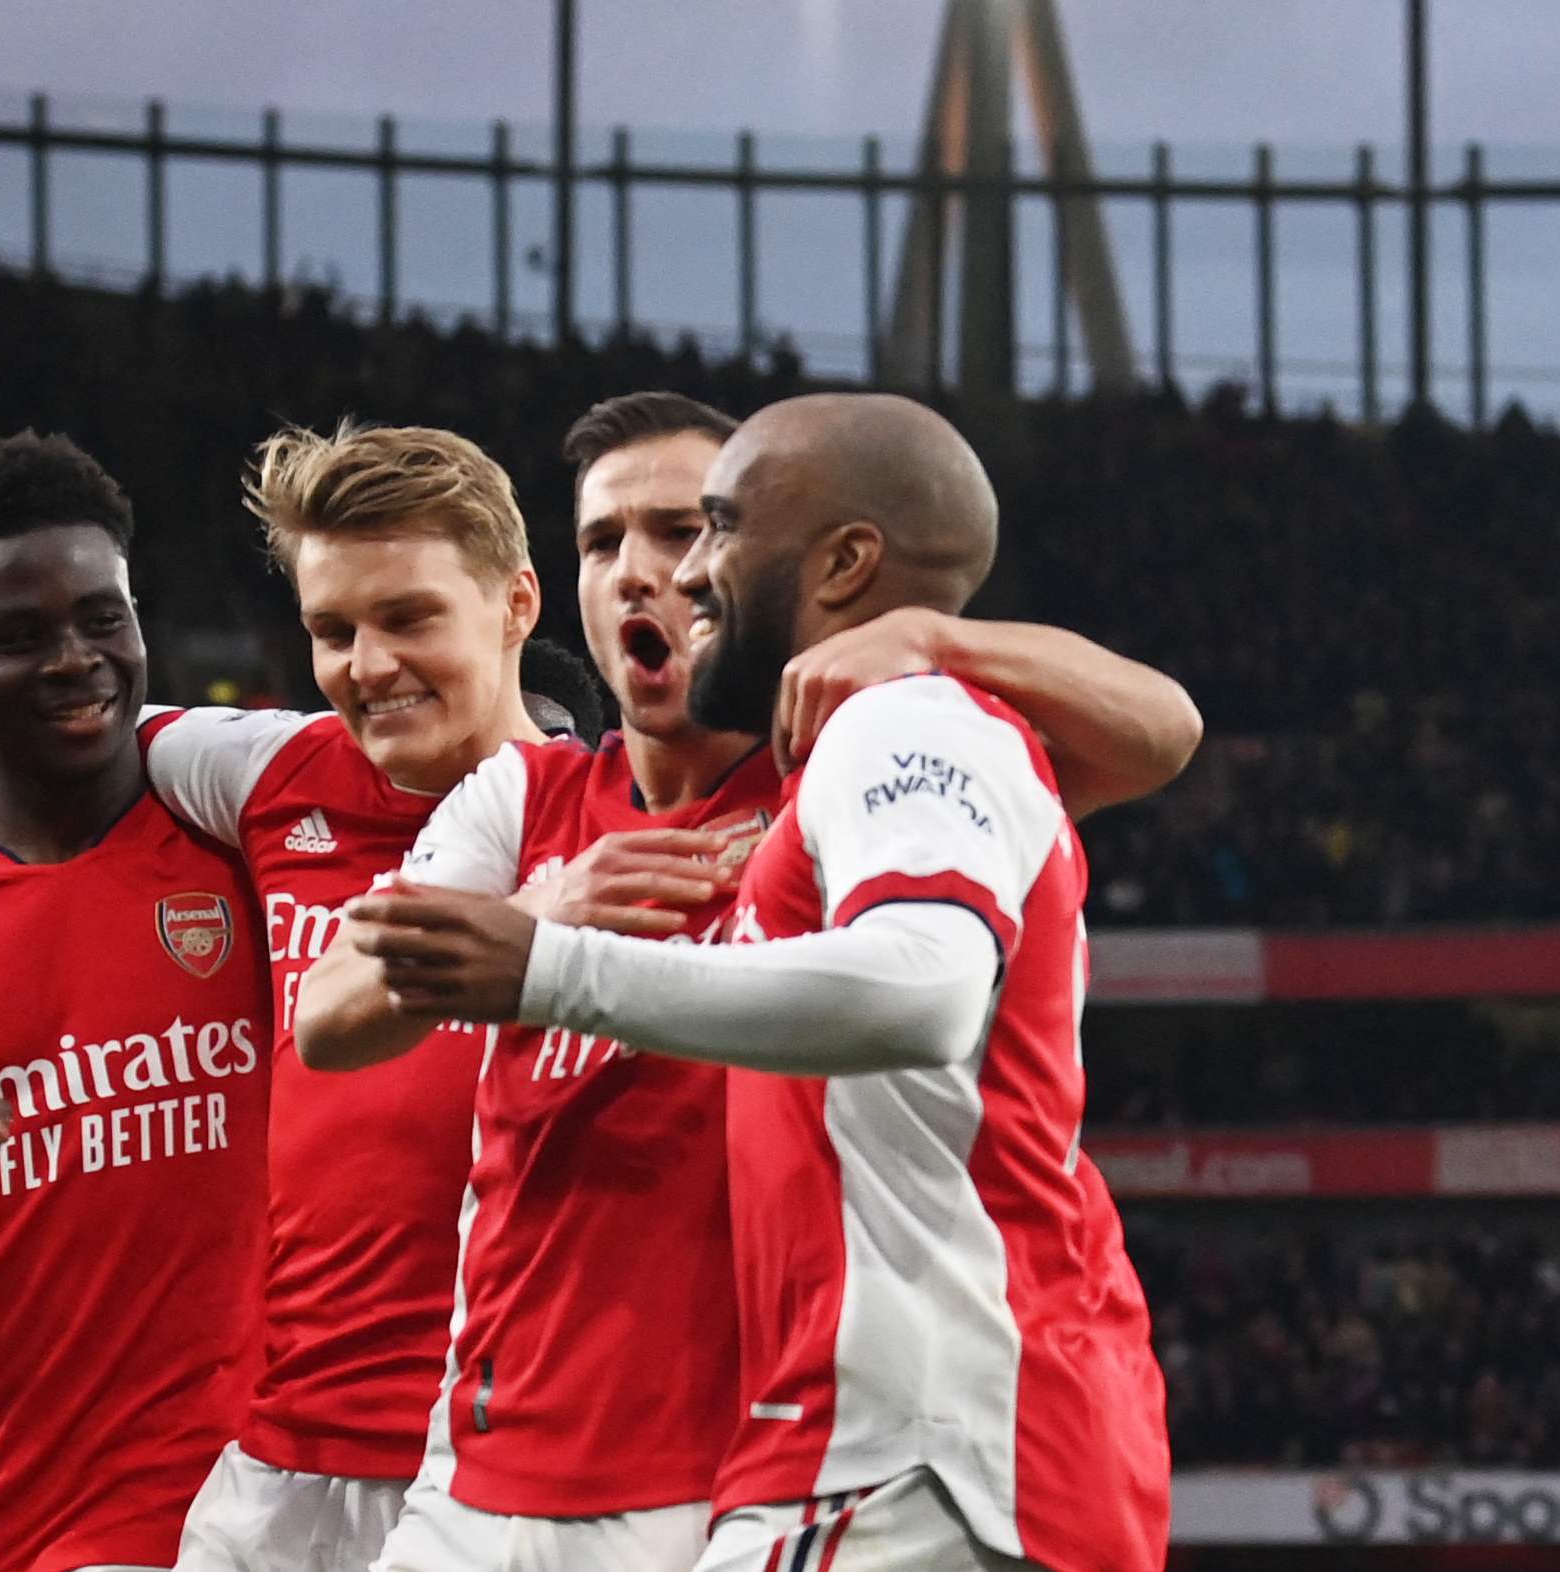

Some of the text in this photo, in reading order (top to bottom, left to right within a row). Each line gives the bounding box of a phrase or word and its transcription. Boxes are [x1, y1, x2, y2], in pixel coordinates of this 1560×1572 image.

[892, 752, 972, 792] VISIT
[166, 906, 223, 924] Arsenal
[0, 1091, 229, 1196] FLY BETTER
